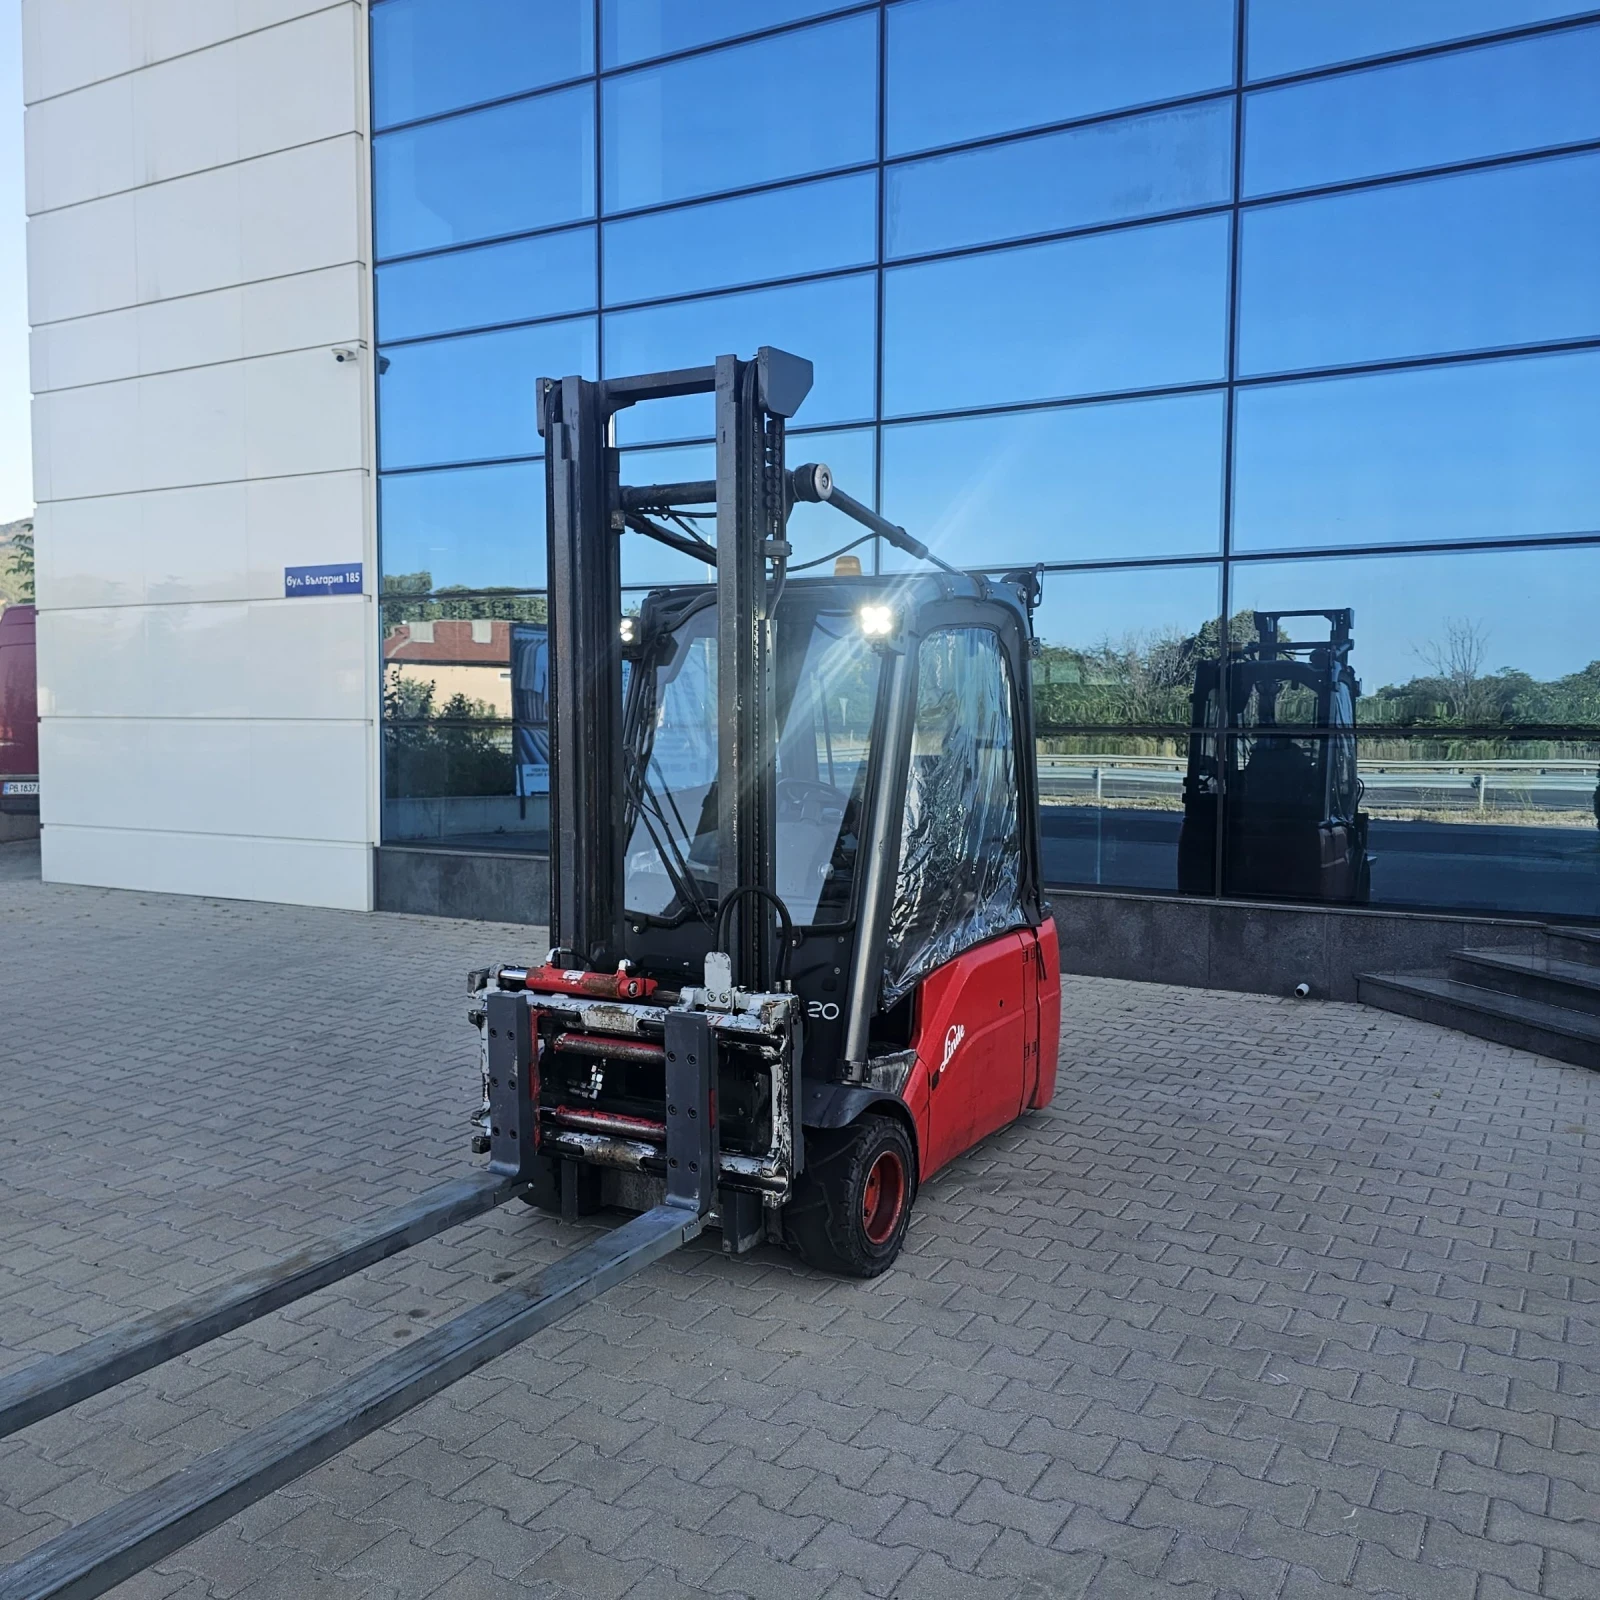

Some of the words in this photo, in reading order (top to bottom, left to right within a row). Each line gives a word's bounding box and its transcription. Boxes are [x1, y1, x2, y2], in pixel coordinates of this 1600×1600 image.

[286, 575, 304, 588] бул.
[305, 574, 344, 586] България
[345, 572, 361, 583] 185
[807, 1000, 840, 1020] 20
[939, 1023, 966, 1073] Linde
